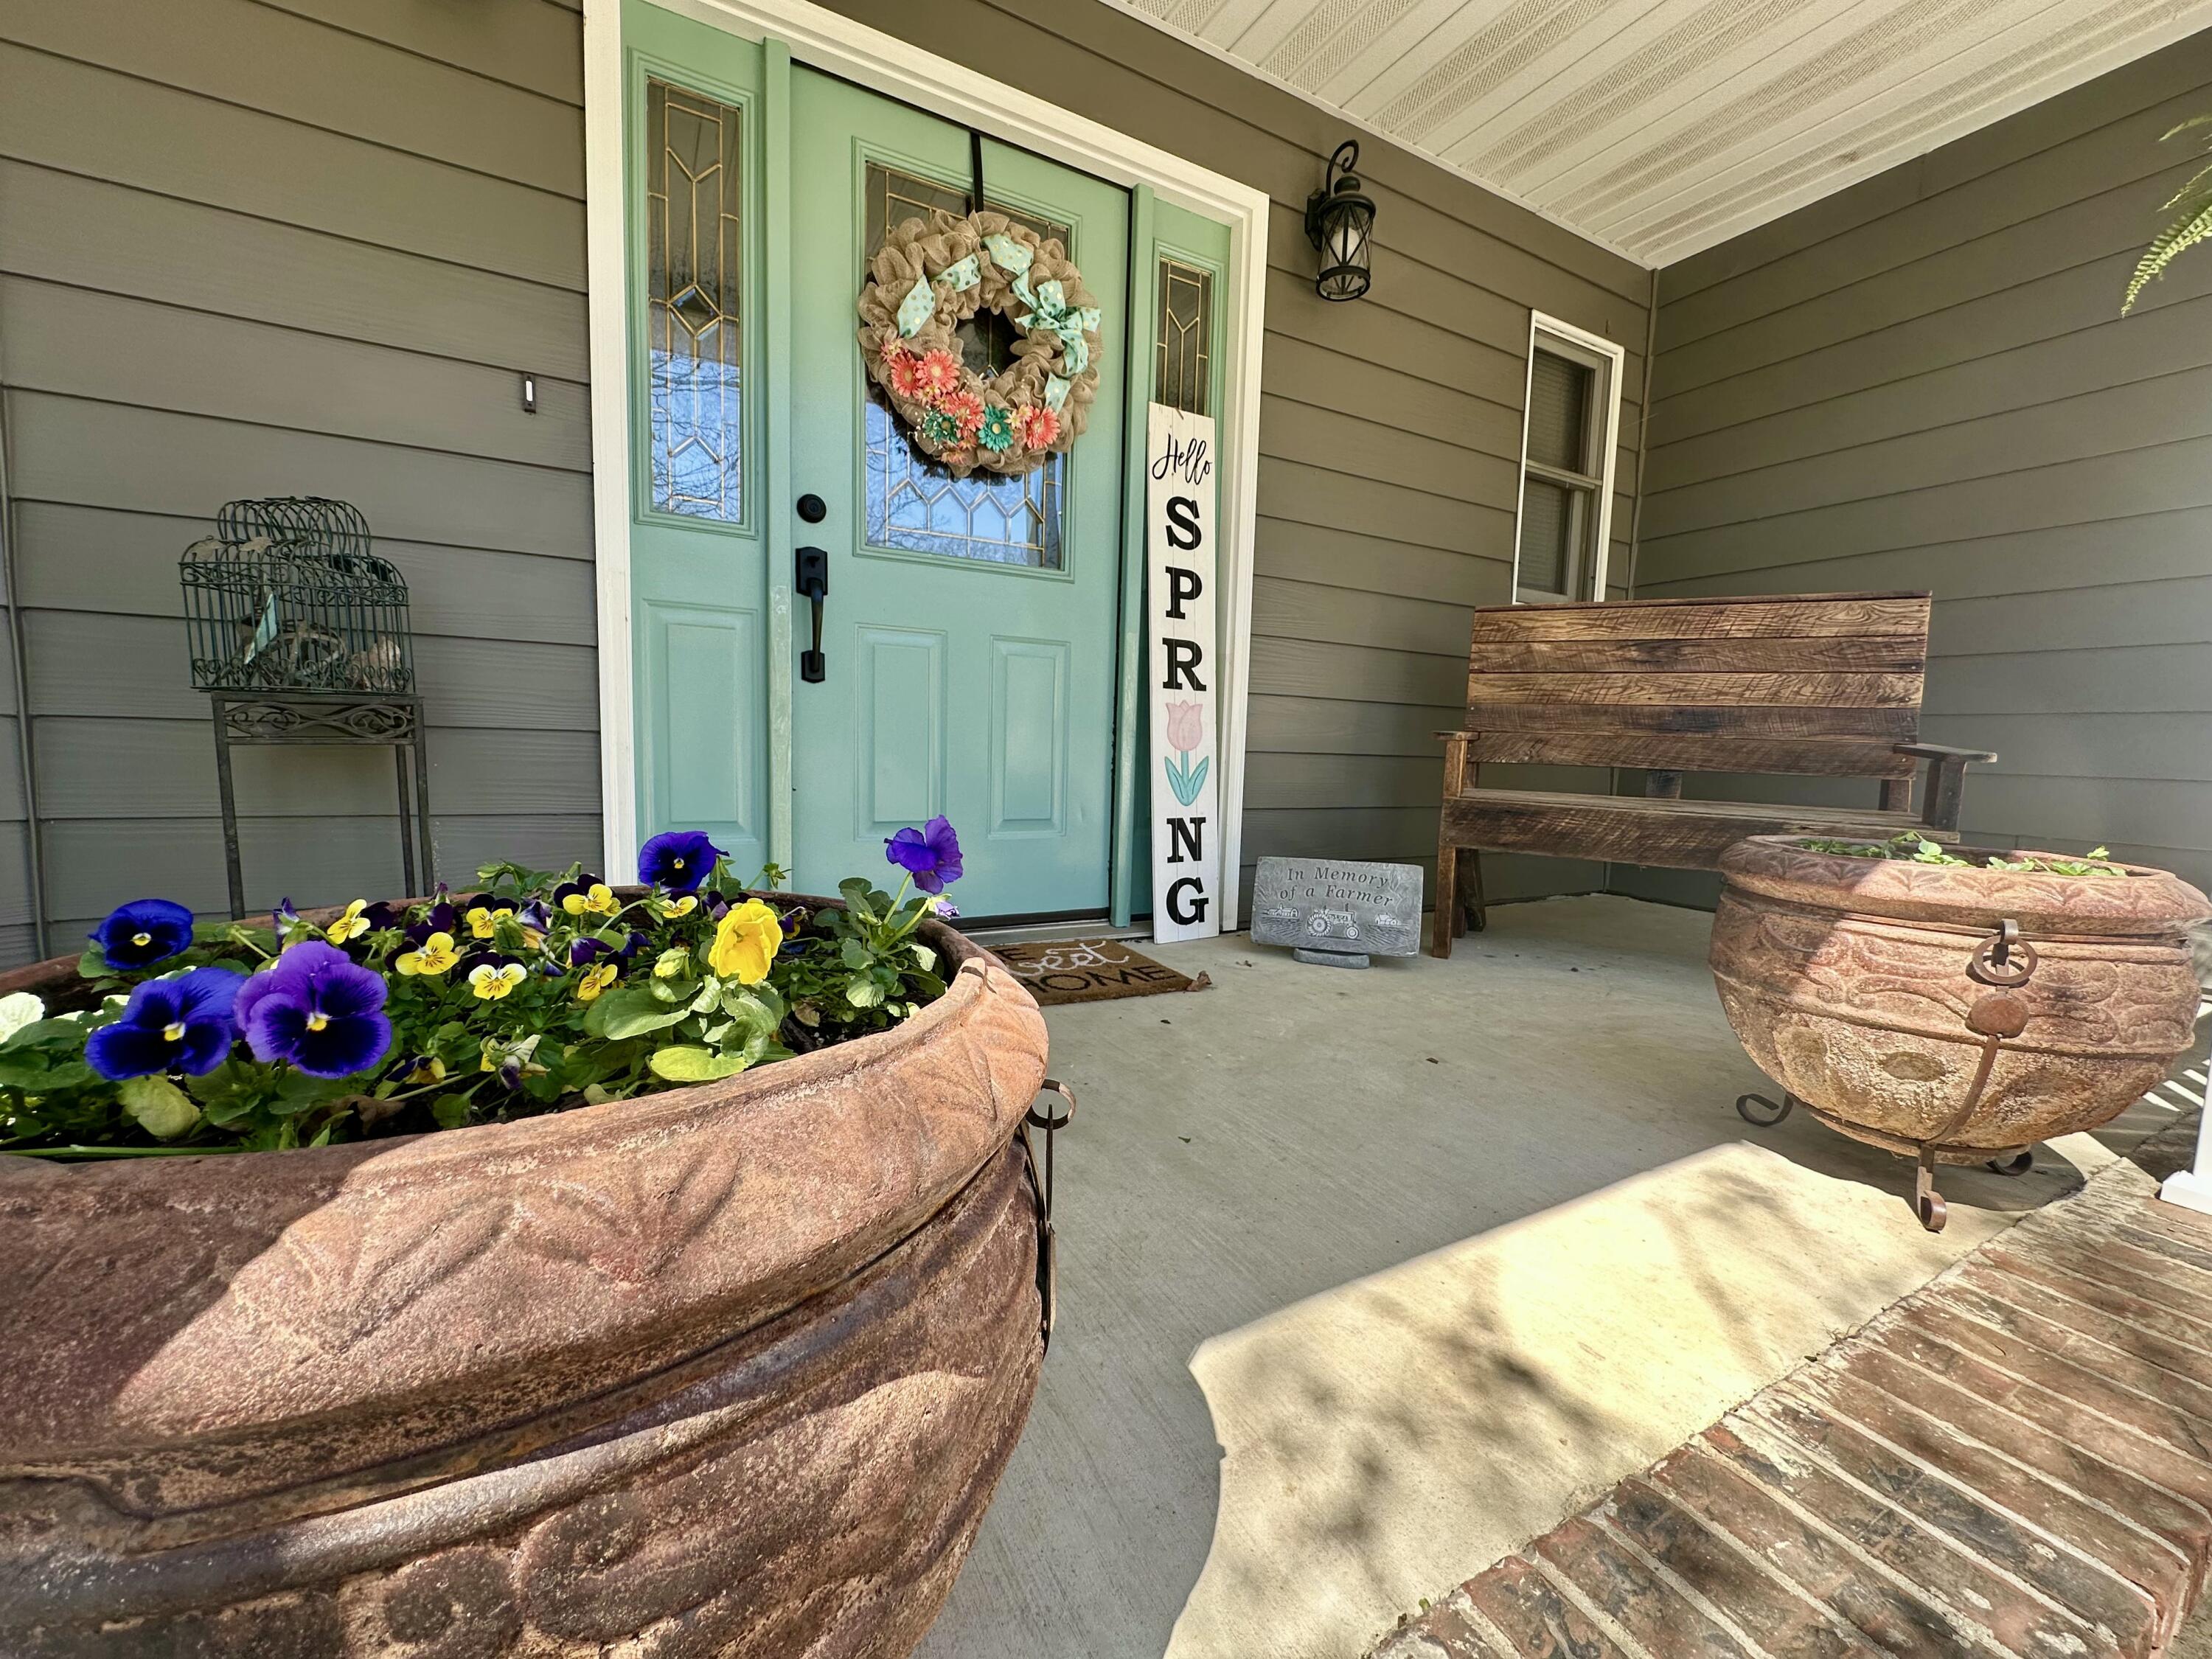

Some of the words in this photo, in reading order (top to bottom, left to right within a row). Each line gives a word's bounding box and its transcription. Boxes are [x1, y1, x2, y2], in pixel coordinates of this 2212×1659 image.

[1152, 438, 1214, 485] Hello
[1287, 869, 1304, 881] In
[1314, 867, 1388, 888] Memory
[1280, 886, 1298, 901] of
[1306, 887, 1315, 897] a
[1326, 885, 1393, 907] Farmer
[1008, 940, 1130, 976] eet
